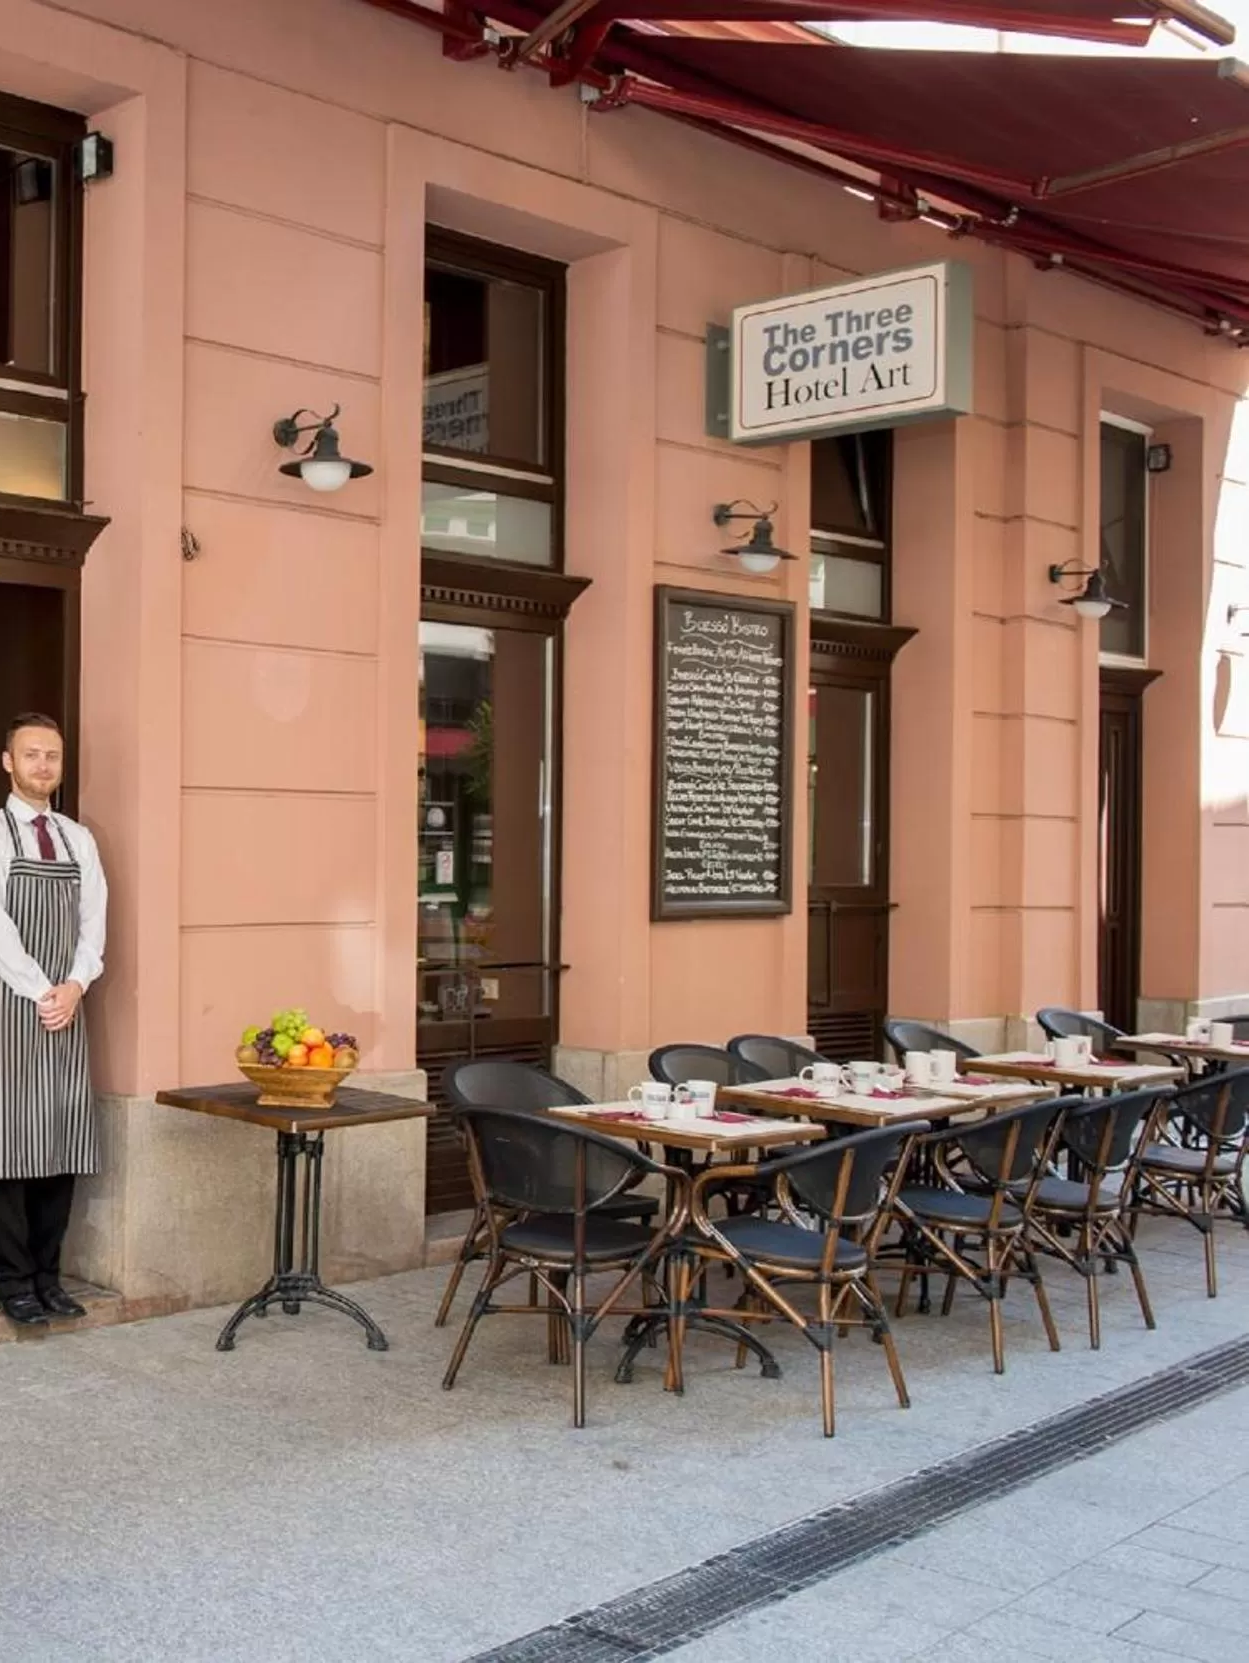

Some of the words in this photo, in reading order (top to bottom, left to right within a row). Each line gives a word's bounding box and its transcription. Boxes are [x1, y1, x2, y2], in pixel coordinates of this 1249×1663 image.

[763, 322, 816, 348] The
[825, 304, 912, 337] Three
[763, 327, 912, 376] Corners
[764, 367, 848, 410] Hotel
[860, 363, 911, 394] Art
